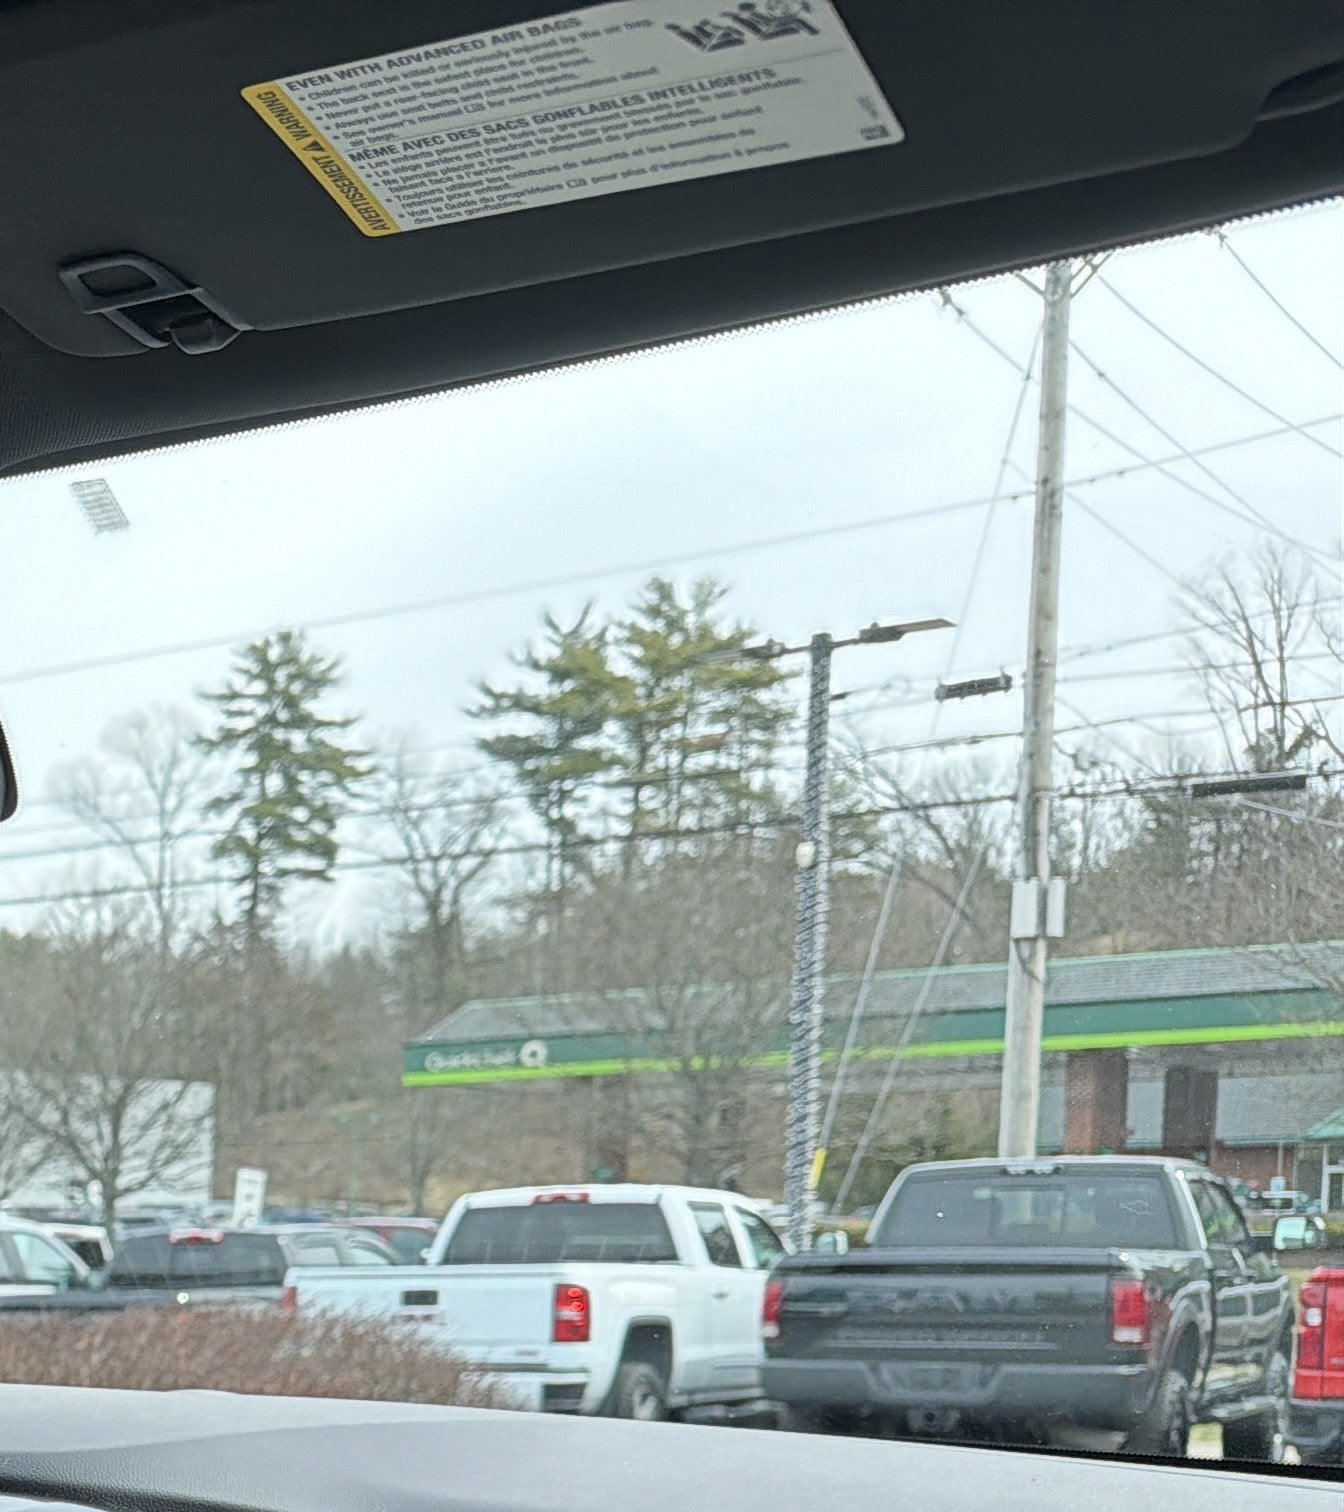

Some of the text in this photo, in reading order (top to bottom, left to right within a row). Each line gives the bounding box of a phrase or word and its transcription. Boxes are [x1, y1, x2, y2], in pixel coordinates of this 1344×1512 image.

[287, 18, 582, 91] EVEN WITH ADVANCED AIR BAGS
[309, 85, 358, 99] Children
[349, 68, 776, 161] MÊME AVEC DES SACS GONFLABLES INTELLIGENTS
[257, 90, 391, 231] AVERTISSEMENT WARNING
